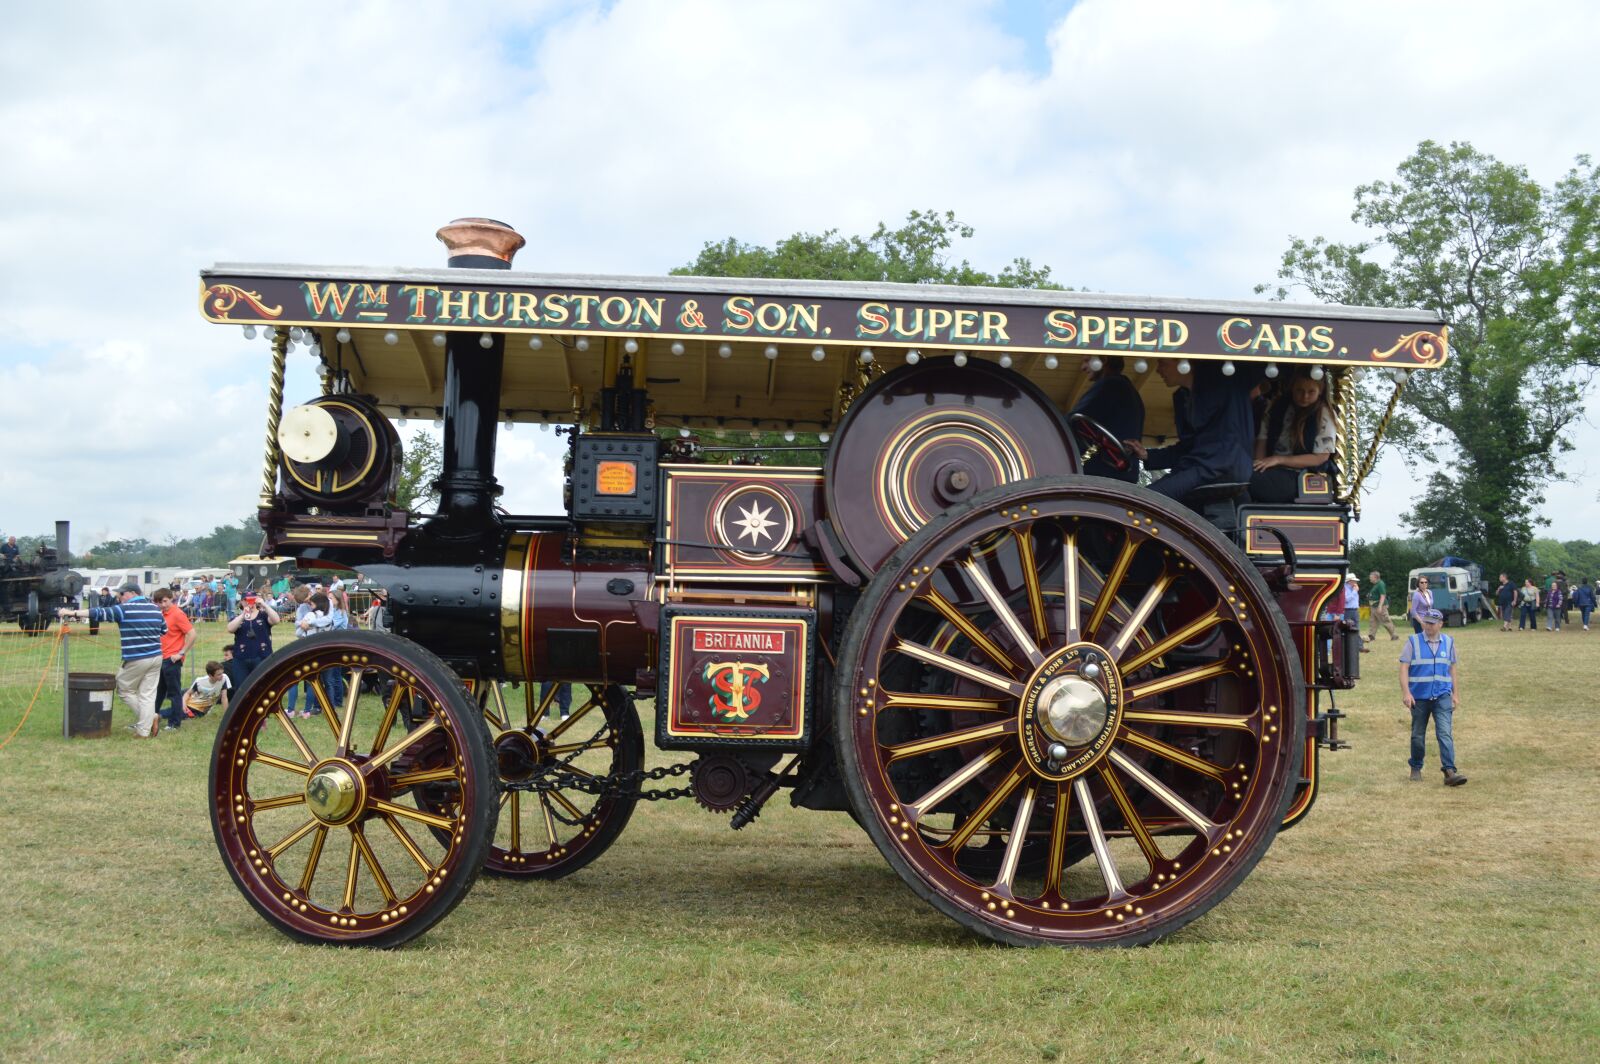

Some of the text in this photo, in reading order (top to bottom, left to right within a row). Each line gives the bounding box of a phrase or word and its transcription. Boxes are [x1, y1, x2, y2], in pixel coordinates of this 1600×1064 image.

[399, 285, 666, 329] THURSTON
[676, 298, 707, 332] &
[722, 296, 832, 338] SON.
[857, 302, 1011, 344] SUPER
[1044, 309, 1189, 351] SPEED
[1217, 317, 1349, 358] CARS.
[704, 633, 773, 650] BRITANNIA
[1044, 658, 1064, 676] SONS
[1100, 660, 1117, 705] ENGINEERS
[1026, 685, 1042, 719] BURRELL
[1025, 724, 1041, 763] CHARLES
[1094, 710, 1117, 750] THETFORD
[1061, 750, 1095, 773] ENGLAND
